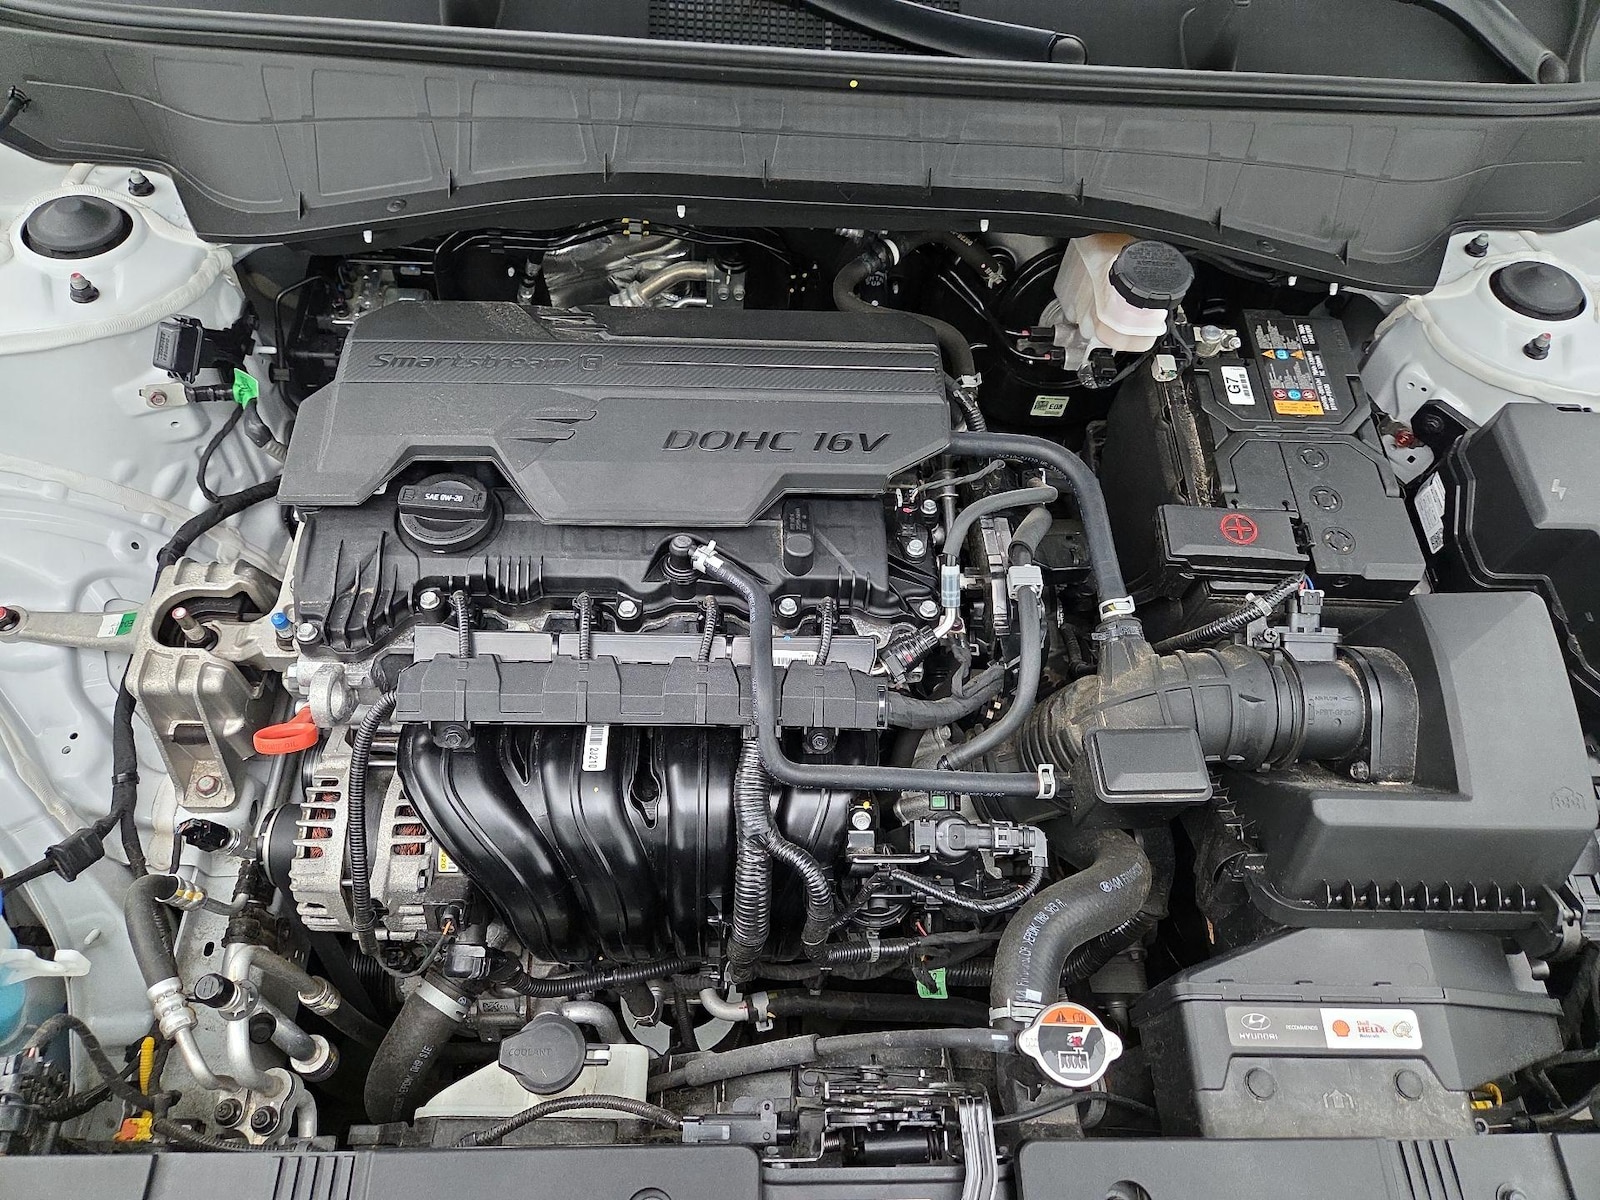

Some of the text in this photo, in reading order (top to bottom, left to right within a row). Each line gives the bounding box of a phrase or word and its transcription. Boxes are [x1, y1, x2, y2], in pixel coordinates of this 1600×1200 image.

[367, 352, 571, 370] Smartstream
[1225, 376, 1241, 394] G7
[661, 429, 893, 454] DOHC 16V
[424, 493, 464, 502] SAE 0W-20
[1239, 1032, 1279, 1041] HYUNDAI
[507, 1047, 554, 1057] COOLANT
